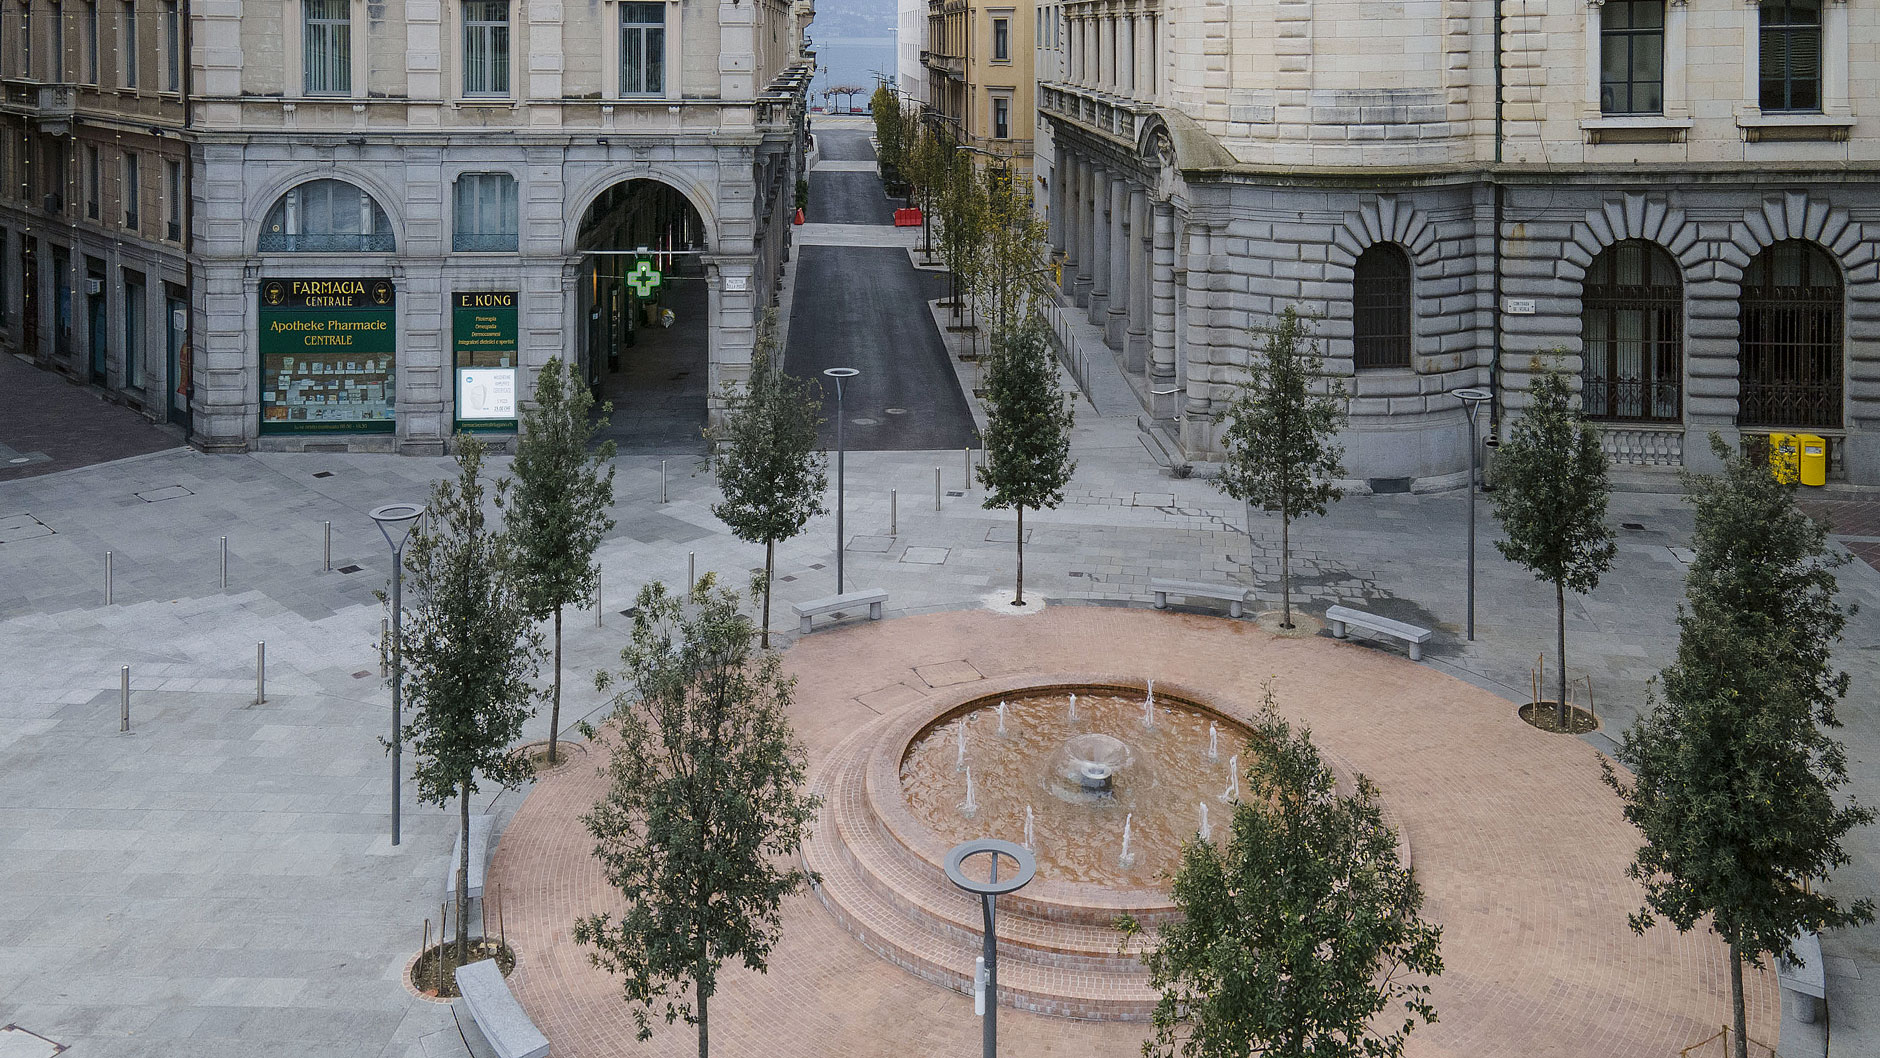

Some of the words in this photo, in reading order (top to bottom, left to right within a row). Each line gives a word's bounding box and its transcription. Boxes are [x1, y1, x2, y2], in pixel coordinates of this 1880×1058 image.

[293, 281, 366, 295] FARMACIA
[305, 296, 353, 307] CENTRALE
[462, 295, 473, 307] E.
[475, 294, 511, 307] KÜNG
[270, 320, 325, 333] Apotheke
[328, 320, 387, 331] Pharmacie
[304, 335, 353, 346] CENTRALE
